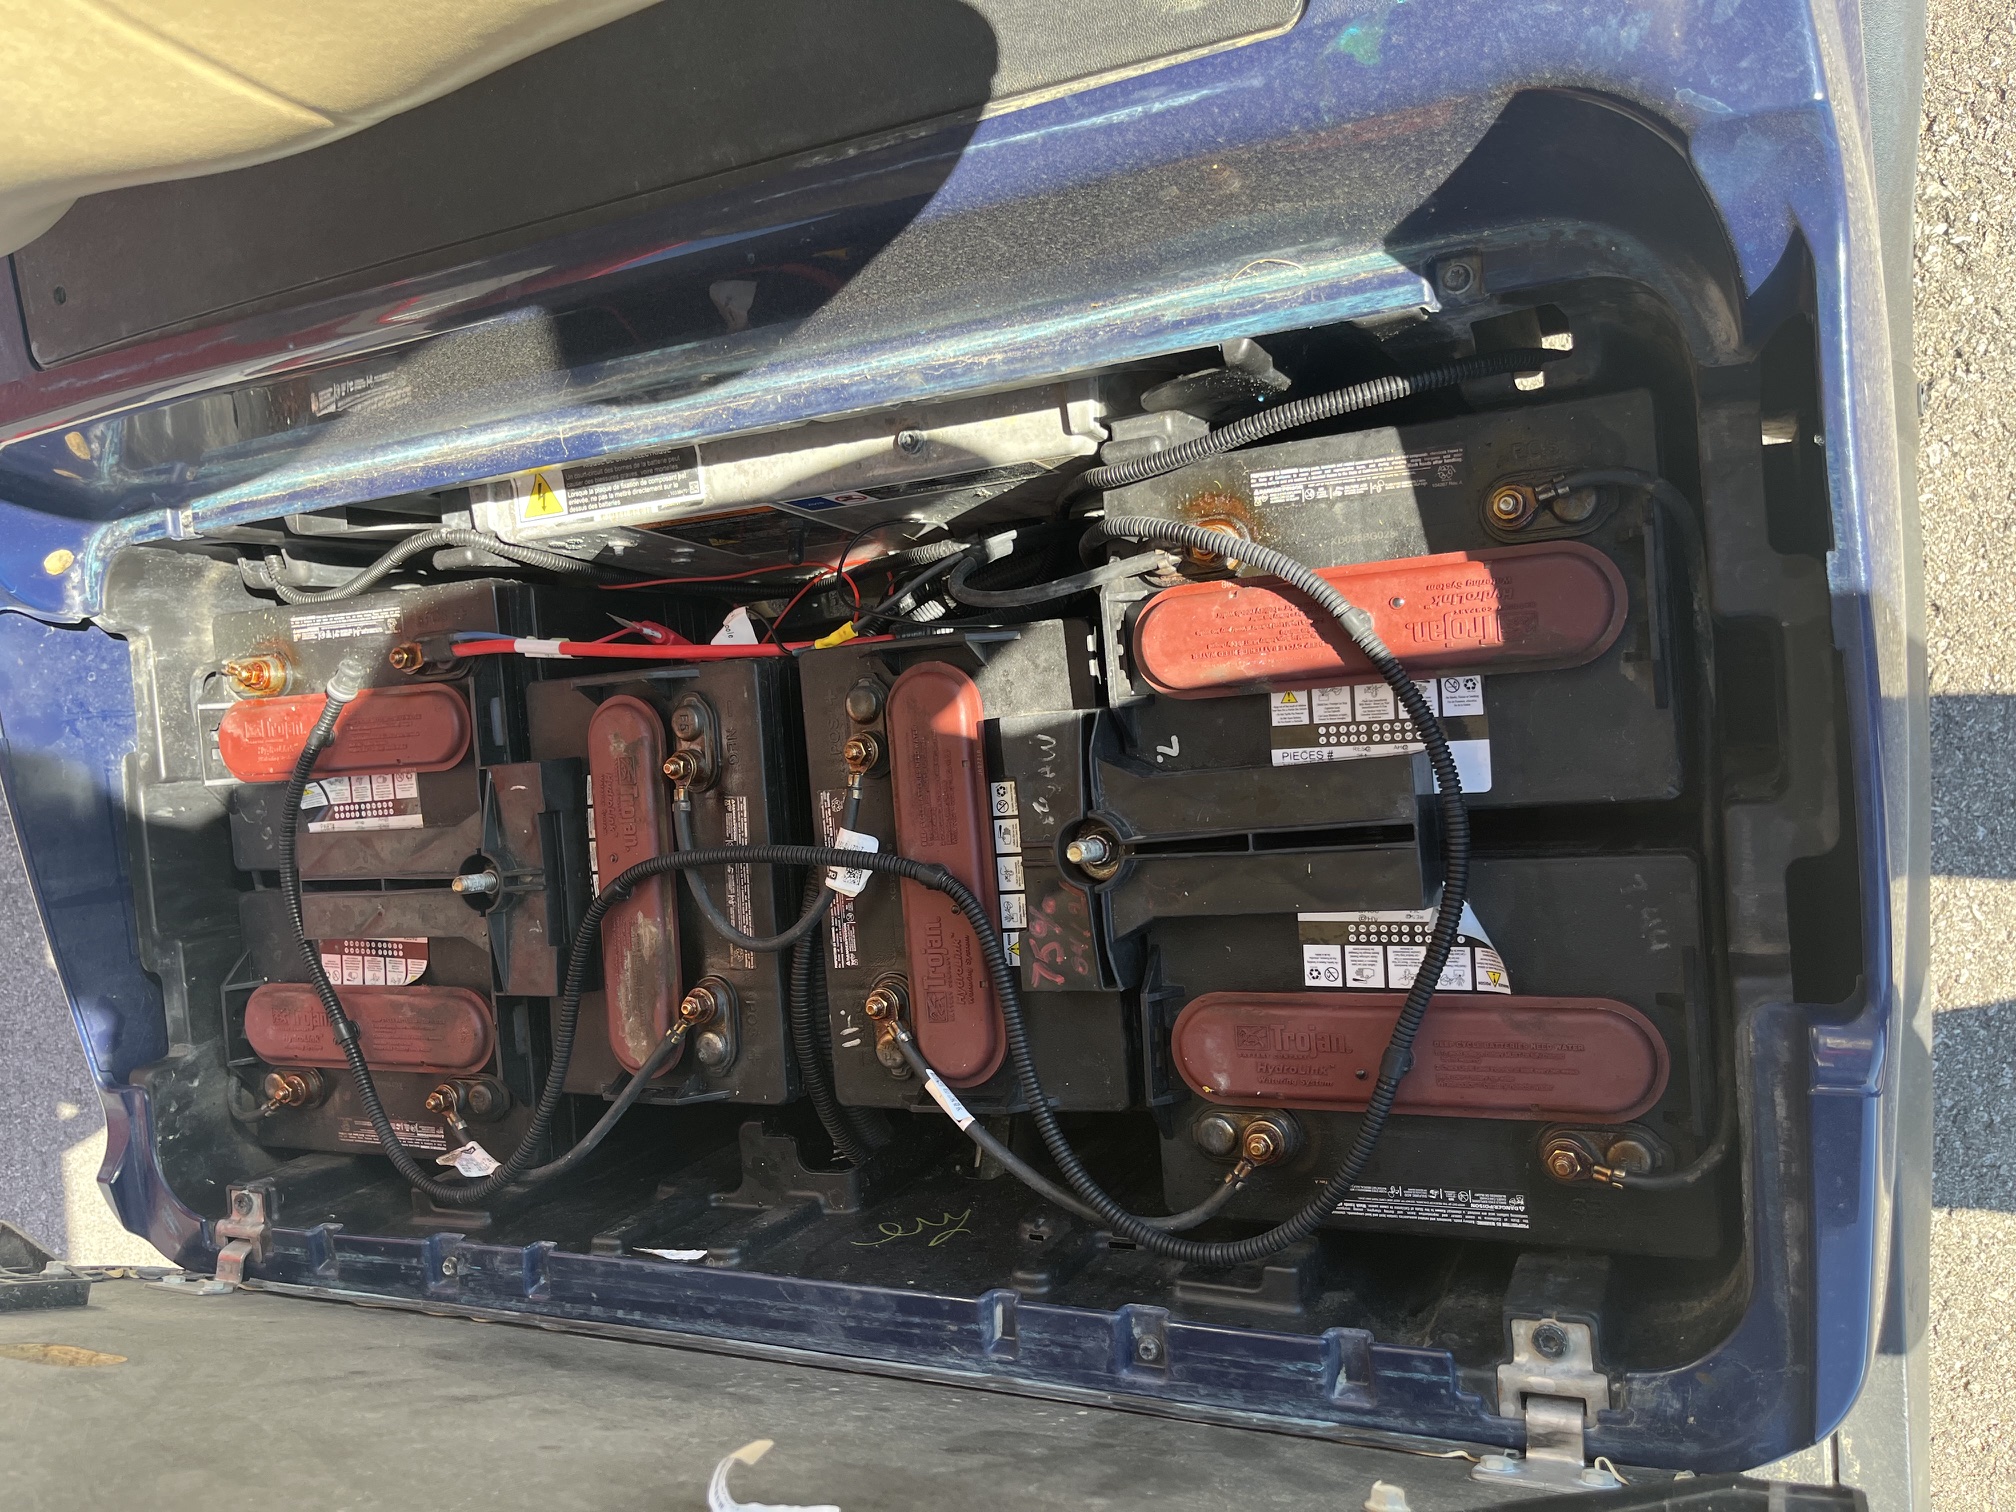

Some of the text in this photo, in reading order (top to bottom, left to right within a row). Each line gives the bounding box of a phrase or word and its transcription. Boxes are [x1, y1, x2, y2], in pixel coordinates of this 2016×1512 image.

[568, 490, 588, 498] Lorsque
[595, 486, 612, 495] plaque
[620, 480, 640, 489] fixation
[648, 474, 678, 484] composant
[598, 494, 608, 502] pas
[632, 484, 663, 496] directement
[569, 500, 621, 514] dessus des batteries
[1411, 611, 1501, 648] Trojan
[1282, 750, 1334, 760] PIECES #
[620, 785, 641, 847] Trojan
[922, 921, 949, 990] Trojan
[1028, 893, 1066, 989] 75%
[1270, 1024, 1346, 1059] Trojan
[1484, 1041, 1529, 1050] BATTERIES
[1554, 1044, 1586, 1052] WATER
